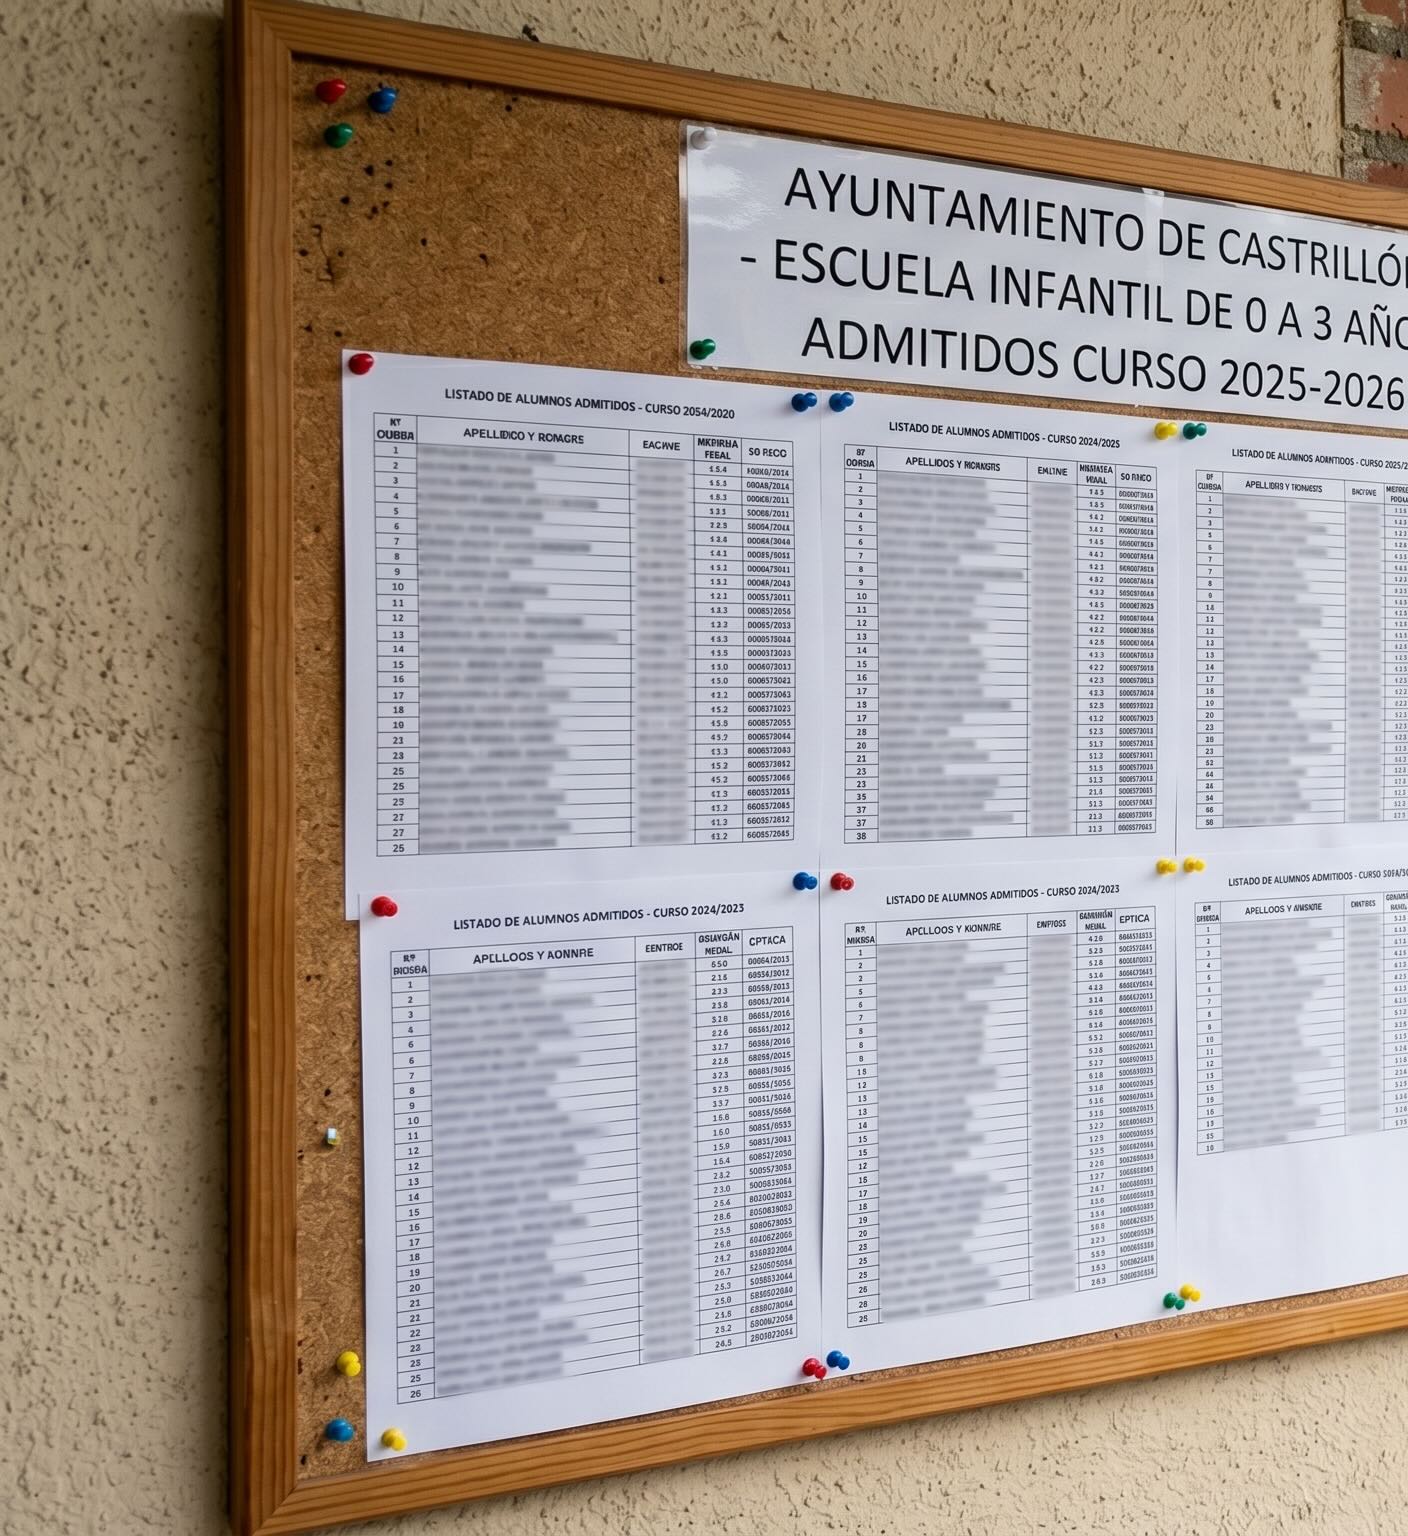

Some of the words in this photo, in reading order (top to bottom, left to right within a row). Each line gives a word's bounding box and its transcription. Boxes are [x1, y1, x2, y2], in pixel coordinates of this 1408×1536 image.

[784, 168, 1144, 252] AYUNTAMIENTO
[1160, 219, 1205, 261] DE
[776, 239, 974, 301] ESCUELA
[991, 265, 1173, 323] INFANTIL
[1187, 290, 1232, 329] DE
[1246, 297, 1266, 333] 0
[1278, 302, 1302, 338] A
[1314, 306, 1332, 341] 3
[799, 318, 1058, 383] ADMITIDOS
[1074, 345, 1206, 392] CURSO
[1218, 359, 1404, 416] 2025-2026
[446, 389, 494, 402] LISTADO
[498, 392, 512, 403] DE
[516, 394, 572, 407] ALUMNOS
[575, 398, 636, 412] ADMITIDOS
[645, 404, 681, 415] CURSO
[683, 406, 735, 419] 2054/2020
[528, 432, 535, 441] Y
[890, 422, 929, 433] LISTADO
[932, 425, 943, 435] DE
[946, 426, 990, 438] ALUMNOS
[992, 430, 1040, 442] ADMITIDOS
[1048, 434, 1077, 445] CURSO
[394, 446, 398, 454] 1
[906, 457, 955, 468] APELLIDOS
[957, 460, 962, 468] Y
[1232, 449, 1264, 459] LISTADO
[1266, 451, 1276, 460] DE
[1278, 452, 1313, 463] ALUMNOS
[1360, 459, 1383, 468] CURSO
[393, 462, 398, 470] 2
[394, 568, 400, 576] 9
[392, 583, 404, 591] 10
[393, 614, 404, 622] 12
[393, 631, 404, 639] 13
[394, 661, 404, 669] 15
[1229, 877, 1260, 887] LISTADO
[1262, 876, 1272, 885] DE
[1274, 874, 1310, 884] ALUMNOS
[1312, 872, 1353, 882] ADMITIDOS
[1359, 870, 1381, 879] CURSO
[887, 895, 925, 905] LISTADO
[928, 894, 939, 903] DE
[942, 892, 988, 902] ALUMNOS
[990, 889, 1039, 900] ADMITIDOS
[1047, 887, 1076, 897] CURSO
[1078, 885, 1120, 895] 2024/2023
[454, 918, 501, 930] LISTADO
[505, 917, 520, 927] DE
[523, 913, 580, 926] ALUMNOS
[583, 910, 644, 922] ADMITIDOS
[653, 907, 689, 918] CURSO
[692, 904, 744, 916] 2024/2023
[1120, 914, 1150, 924] EPTICA
[956, 925, 962, 933] Y
[537, 951, 545, 960] Y
[408, 981, 413, 989] 1
[408, 996, 413, 1004] 2
[408, 1011, 413, 1019] 3
[410, 1087, 415, 1095] 8
[410, 1102, 415, 1110] 9
[408, 1116, 419, 1125] 10
[408, 1132, 418, 1140] 11
[408, 1147, 419, 1155] 12
[408, 1178, 419, 1186] 13
[409, 1193, 420, 1201] 14
[409, 1208, 420, 1217] 15
[410, 1224, 420, 1232] 16
[410, 1238, 420, 1247] 17
[410, 1253, 420, 1262] 18
